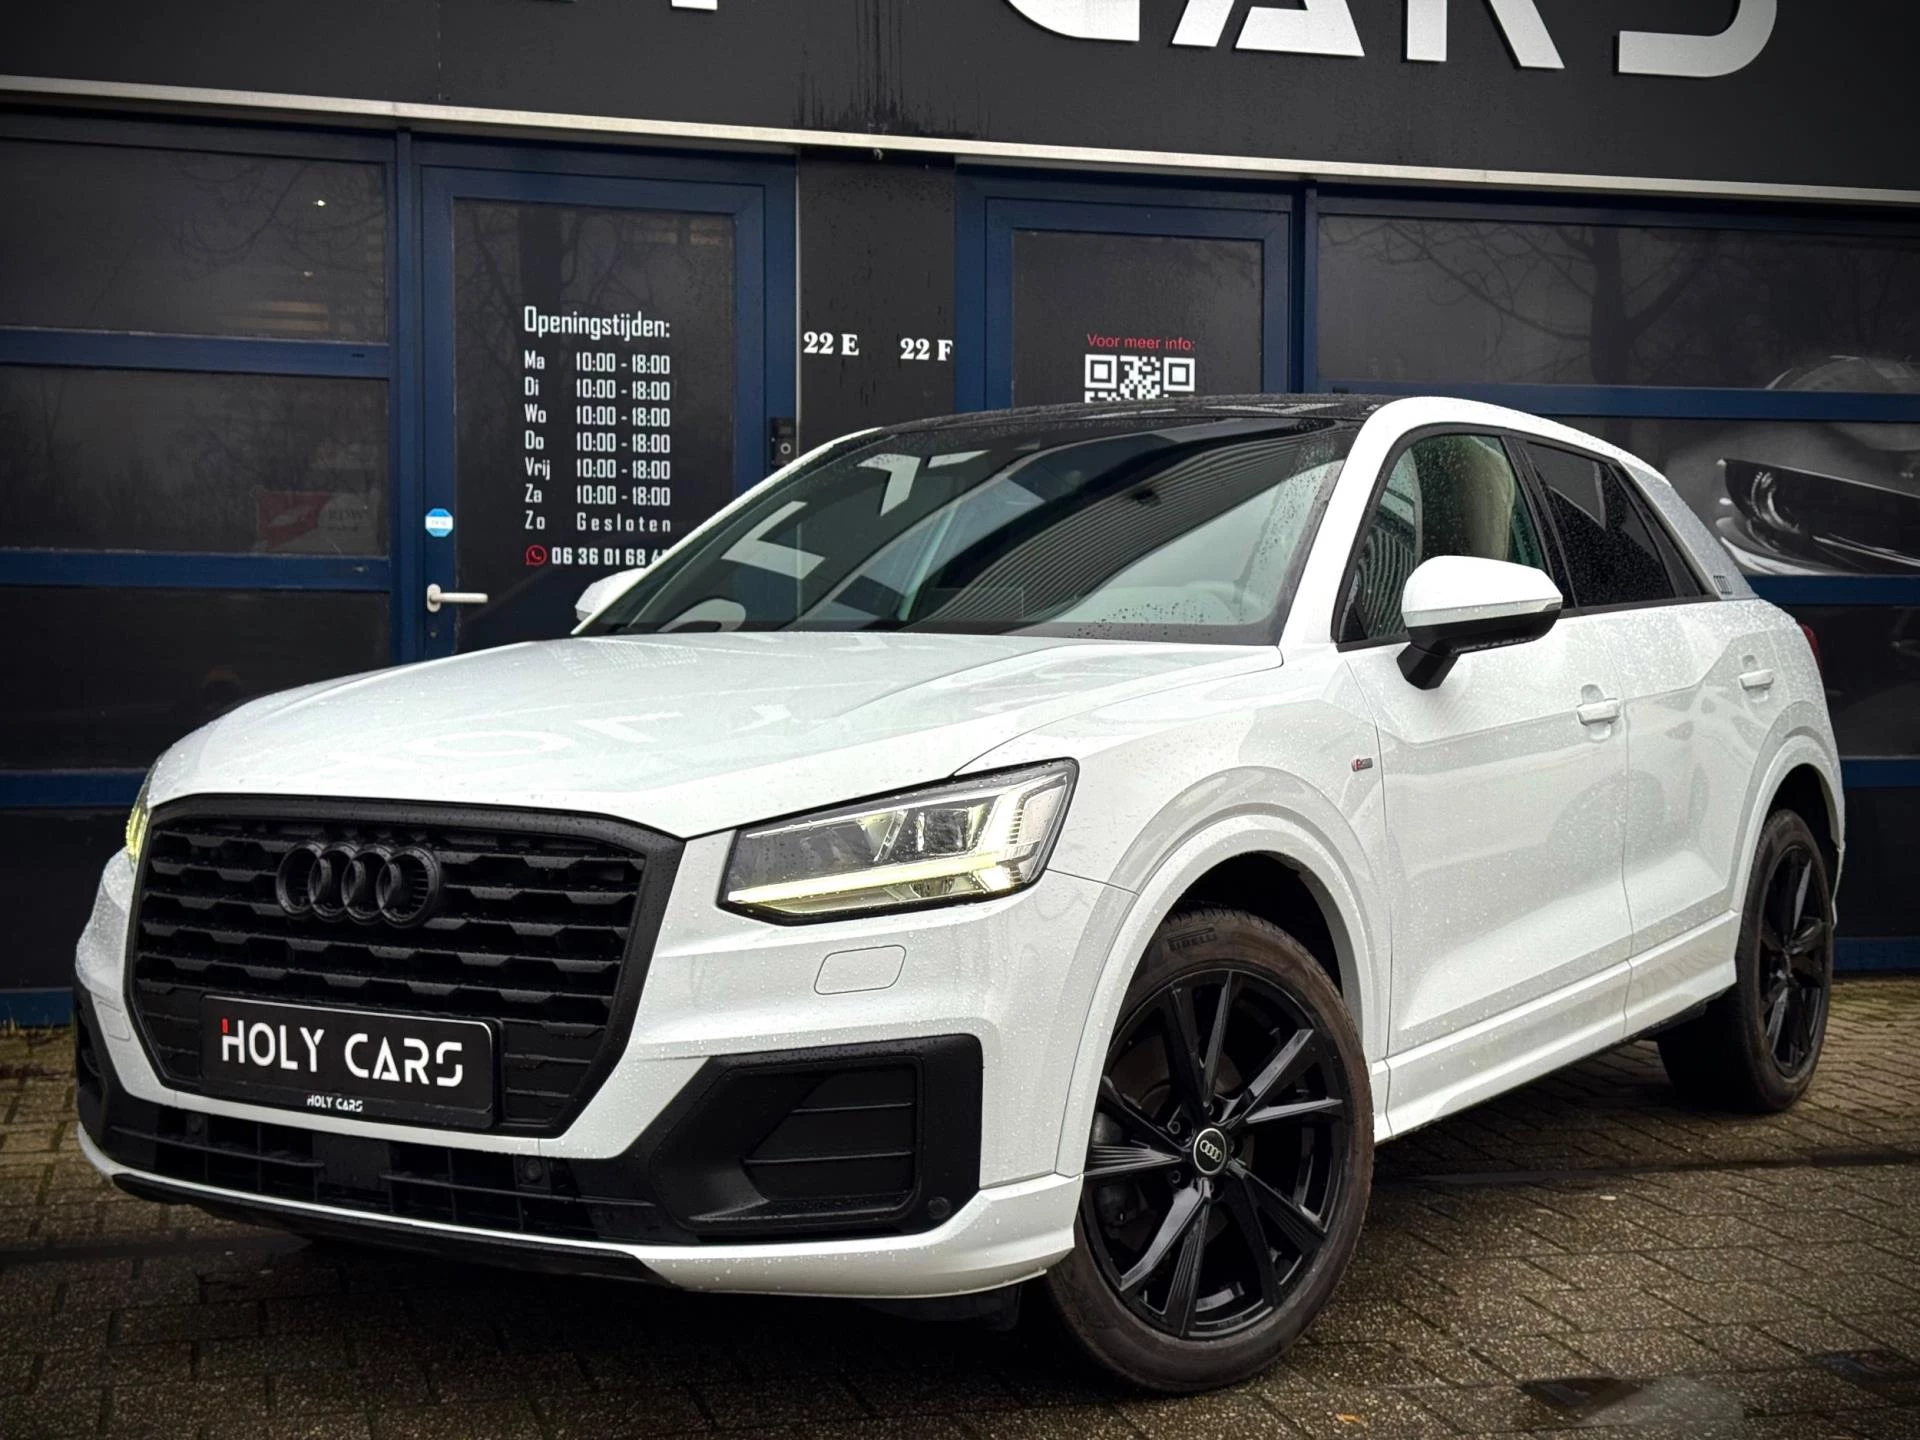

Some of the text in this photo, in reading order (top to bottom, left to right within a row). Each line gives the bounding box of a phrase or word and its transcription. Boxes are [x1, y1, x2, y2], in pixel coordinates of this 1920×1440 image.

[524, 305, 670, 342] Openingstijden:
[803, 331, 860, 356] 22 E
[900, 337, 954, 362] 22 F
[1087, 335, 1196, 350] Voor meer info:
[524, 349, 545, 370] Ma
[576, 351, 616, 373] 10:00
[631, 354, 671, 375] 18:00
[524, 376, 539, 396] Di
[576, 378, 616, 399] 10:00
[631, 380, 671, 401] 18:00
[524, 403, 547, 424] Wo
[576, 405, 617, 426] 10:00
[632, 407, 671, 427] 18:00
[524, 429, 545, 450] Do
[576, 431, 617, 453] 10:00
[632, 433, 671, 454] 18:00
[524, 456, 551, 481] Vrij
[576, 458, 617, 479] 10:00
[632, 459, 671, 480] 18:00
[524, 483, 543, 503] Za
[576, 484, 617, 505] 10:00
[632, 486, 671, 507] 18:00
[524, 509, 671, 533] Zo Gesloten
[551, 546, 573, 565] 06
[577, 547, 599, 565] 36
[603, 547, 620, 566] 01
[625, 548, 646, 566] 68
[220, 1018, 463, 1088] HOLY CARS
[306, 1094, 363, 1113] HOLY CARS
